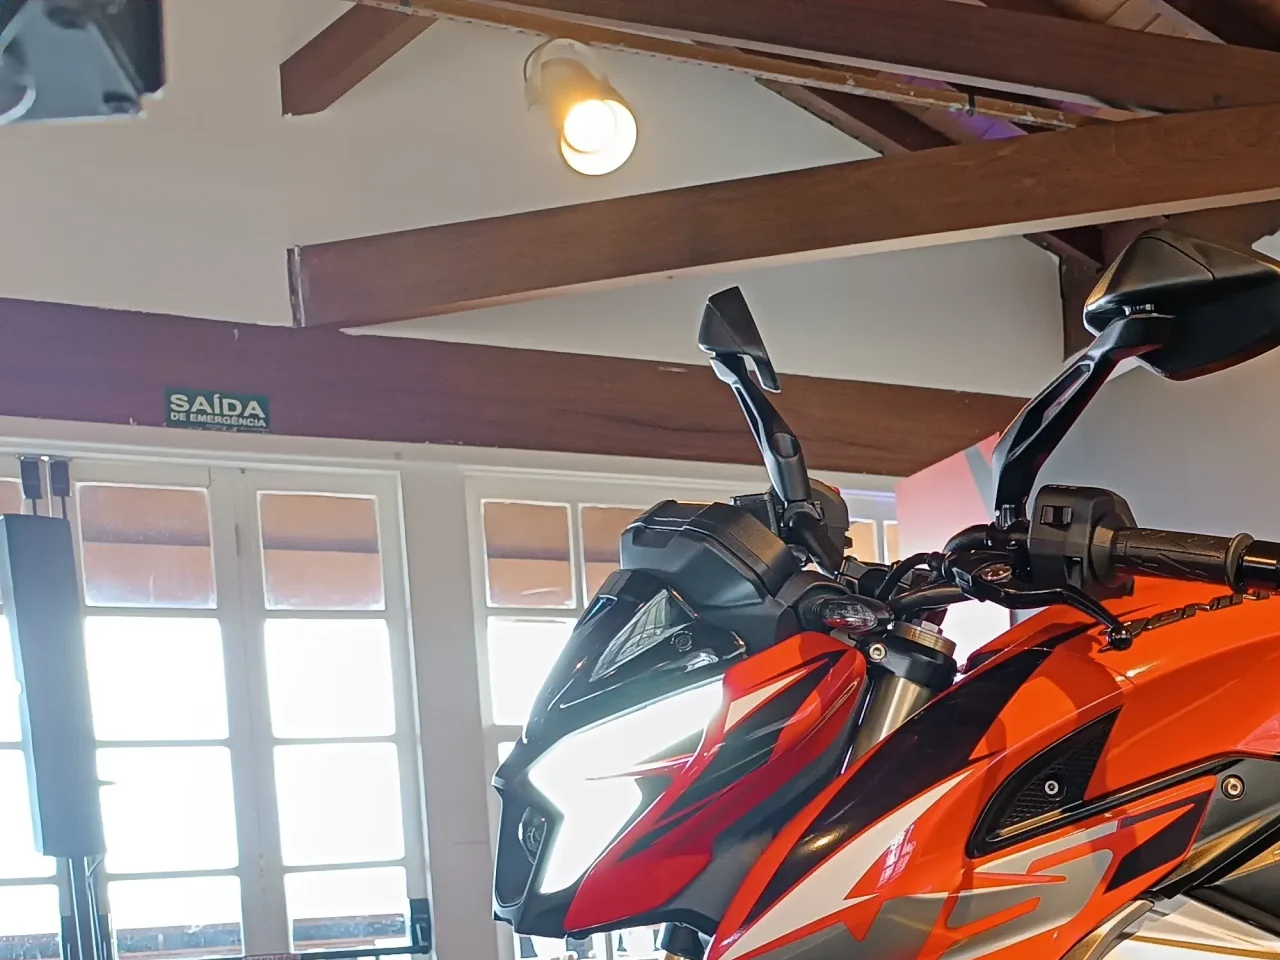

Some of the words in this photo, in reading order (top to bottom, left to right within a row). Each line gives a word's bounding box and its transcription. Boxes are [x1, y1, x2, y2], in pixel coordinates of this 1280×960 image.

[170, 394, 266, 418] SAÍDA
[170, 412, 187, 421] DE
[190, 413, 266, 427] EMERGÊNCIA
